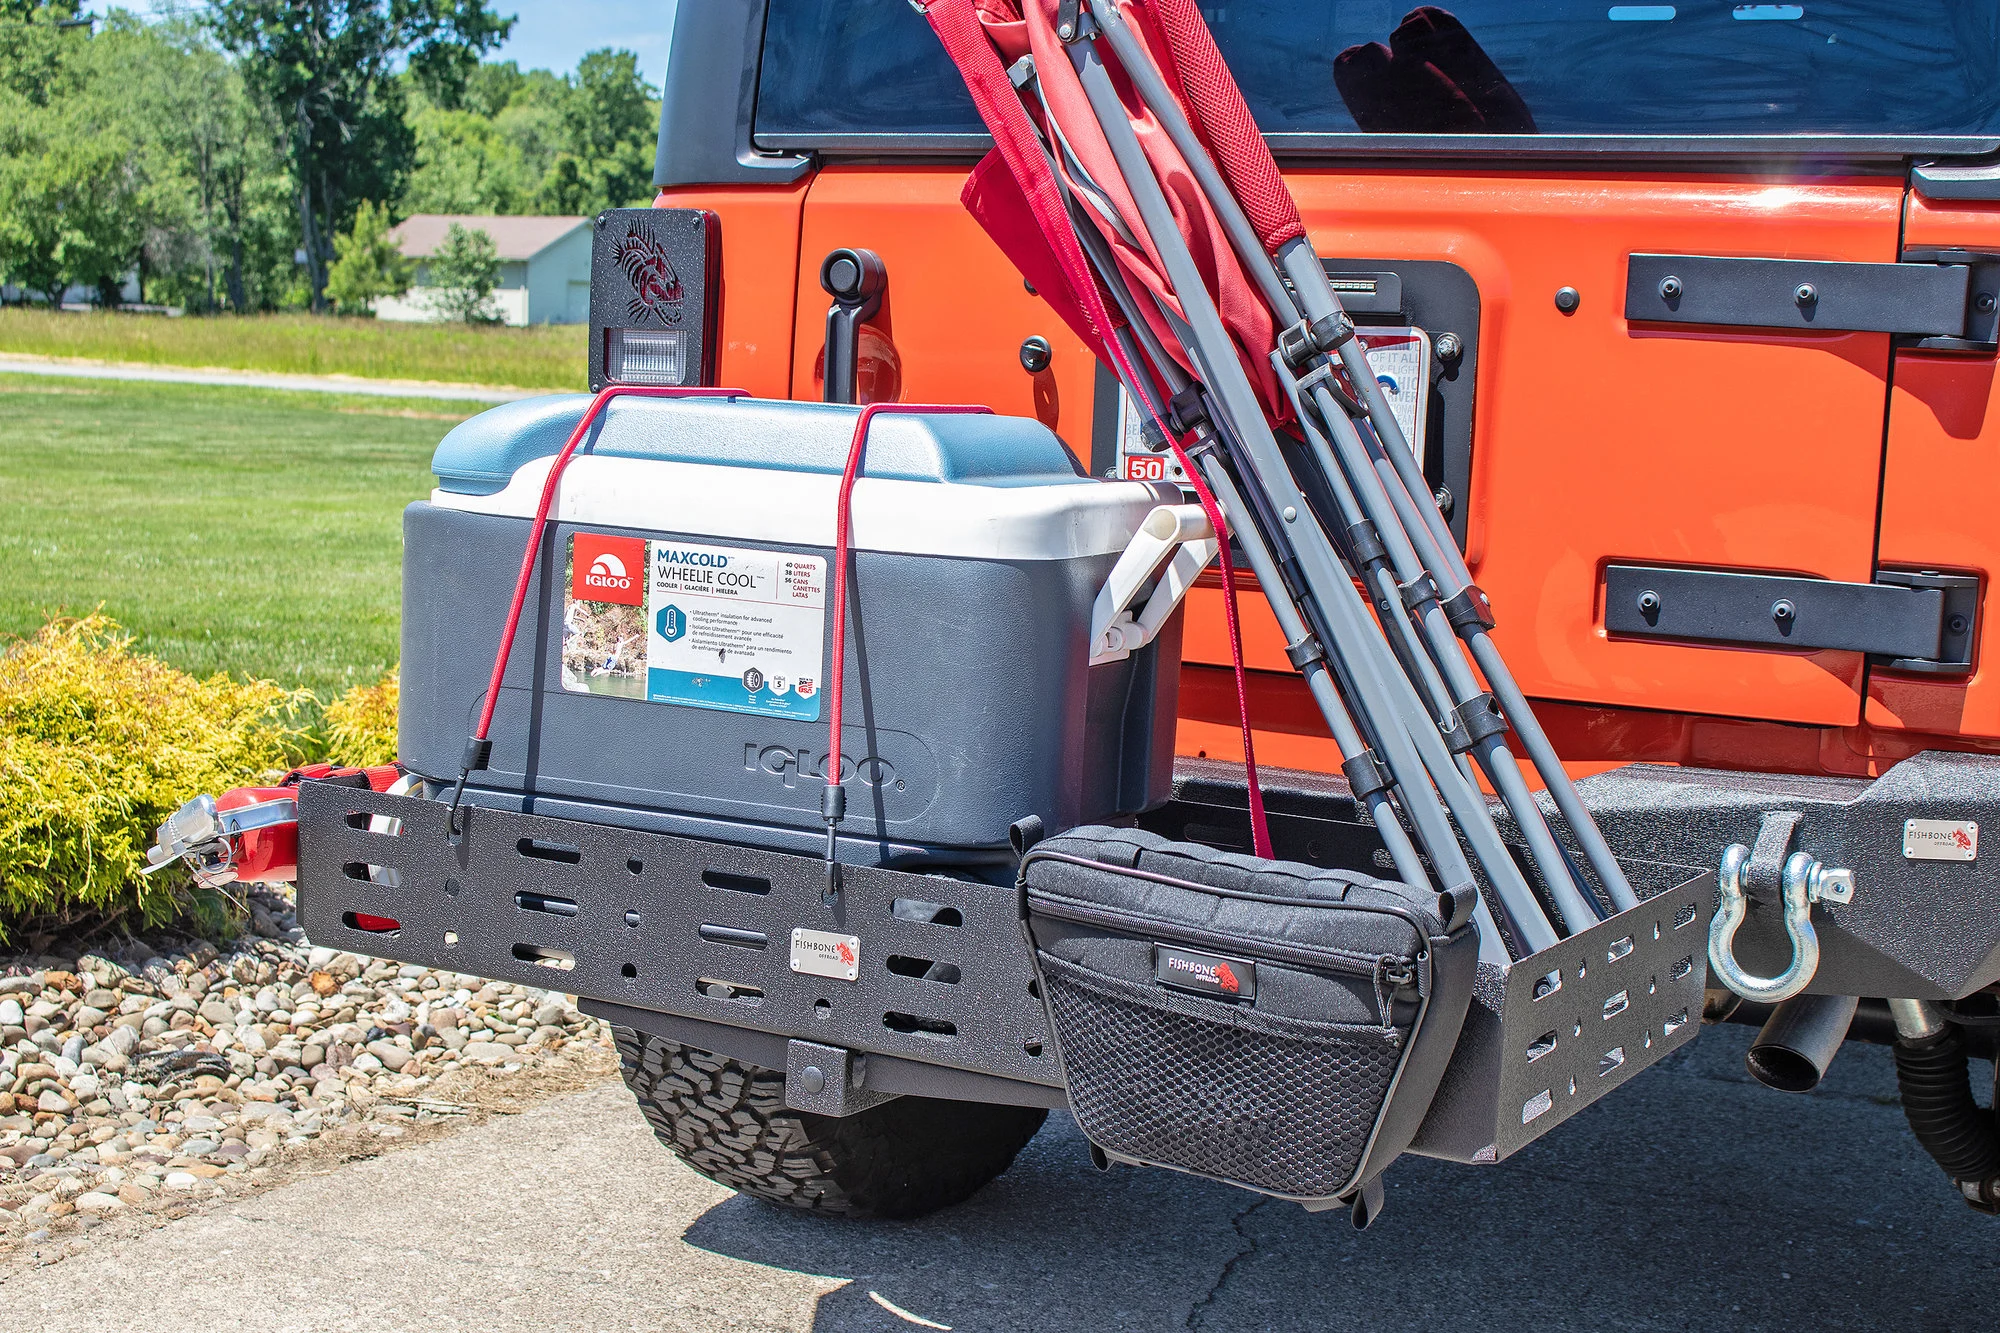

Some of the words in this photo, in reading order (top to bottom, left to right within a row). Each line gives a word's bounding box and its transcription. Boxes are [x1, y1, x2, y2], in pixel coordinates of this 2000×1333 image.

[1371, 352, 1386, 362] OF
[1388, 353, 1398, 363] IT
[1401, 353, 1419, 364] ALL
[1131, 460, 1161, 480] 50
[657, 549, 728, 568] MAXCOLD
[585, 574, 631, 589] IGLOO
[657, 565, 713, 584] WHEELIE
[717, 572, 757, 589] COOL
[656, 581, 678, 589] COOLER
[792, 585, 821, 593] CANETTES
[744, 743, 896, 788] IGLOO
[1908, 831, 1952, 840] FISHBONE
[795, 940, 836, 954] FISHBONE
[1168, 957, 1216, 977] FISHBONE
[1195, 974, 1220, 984] OFFROAD
